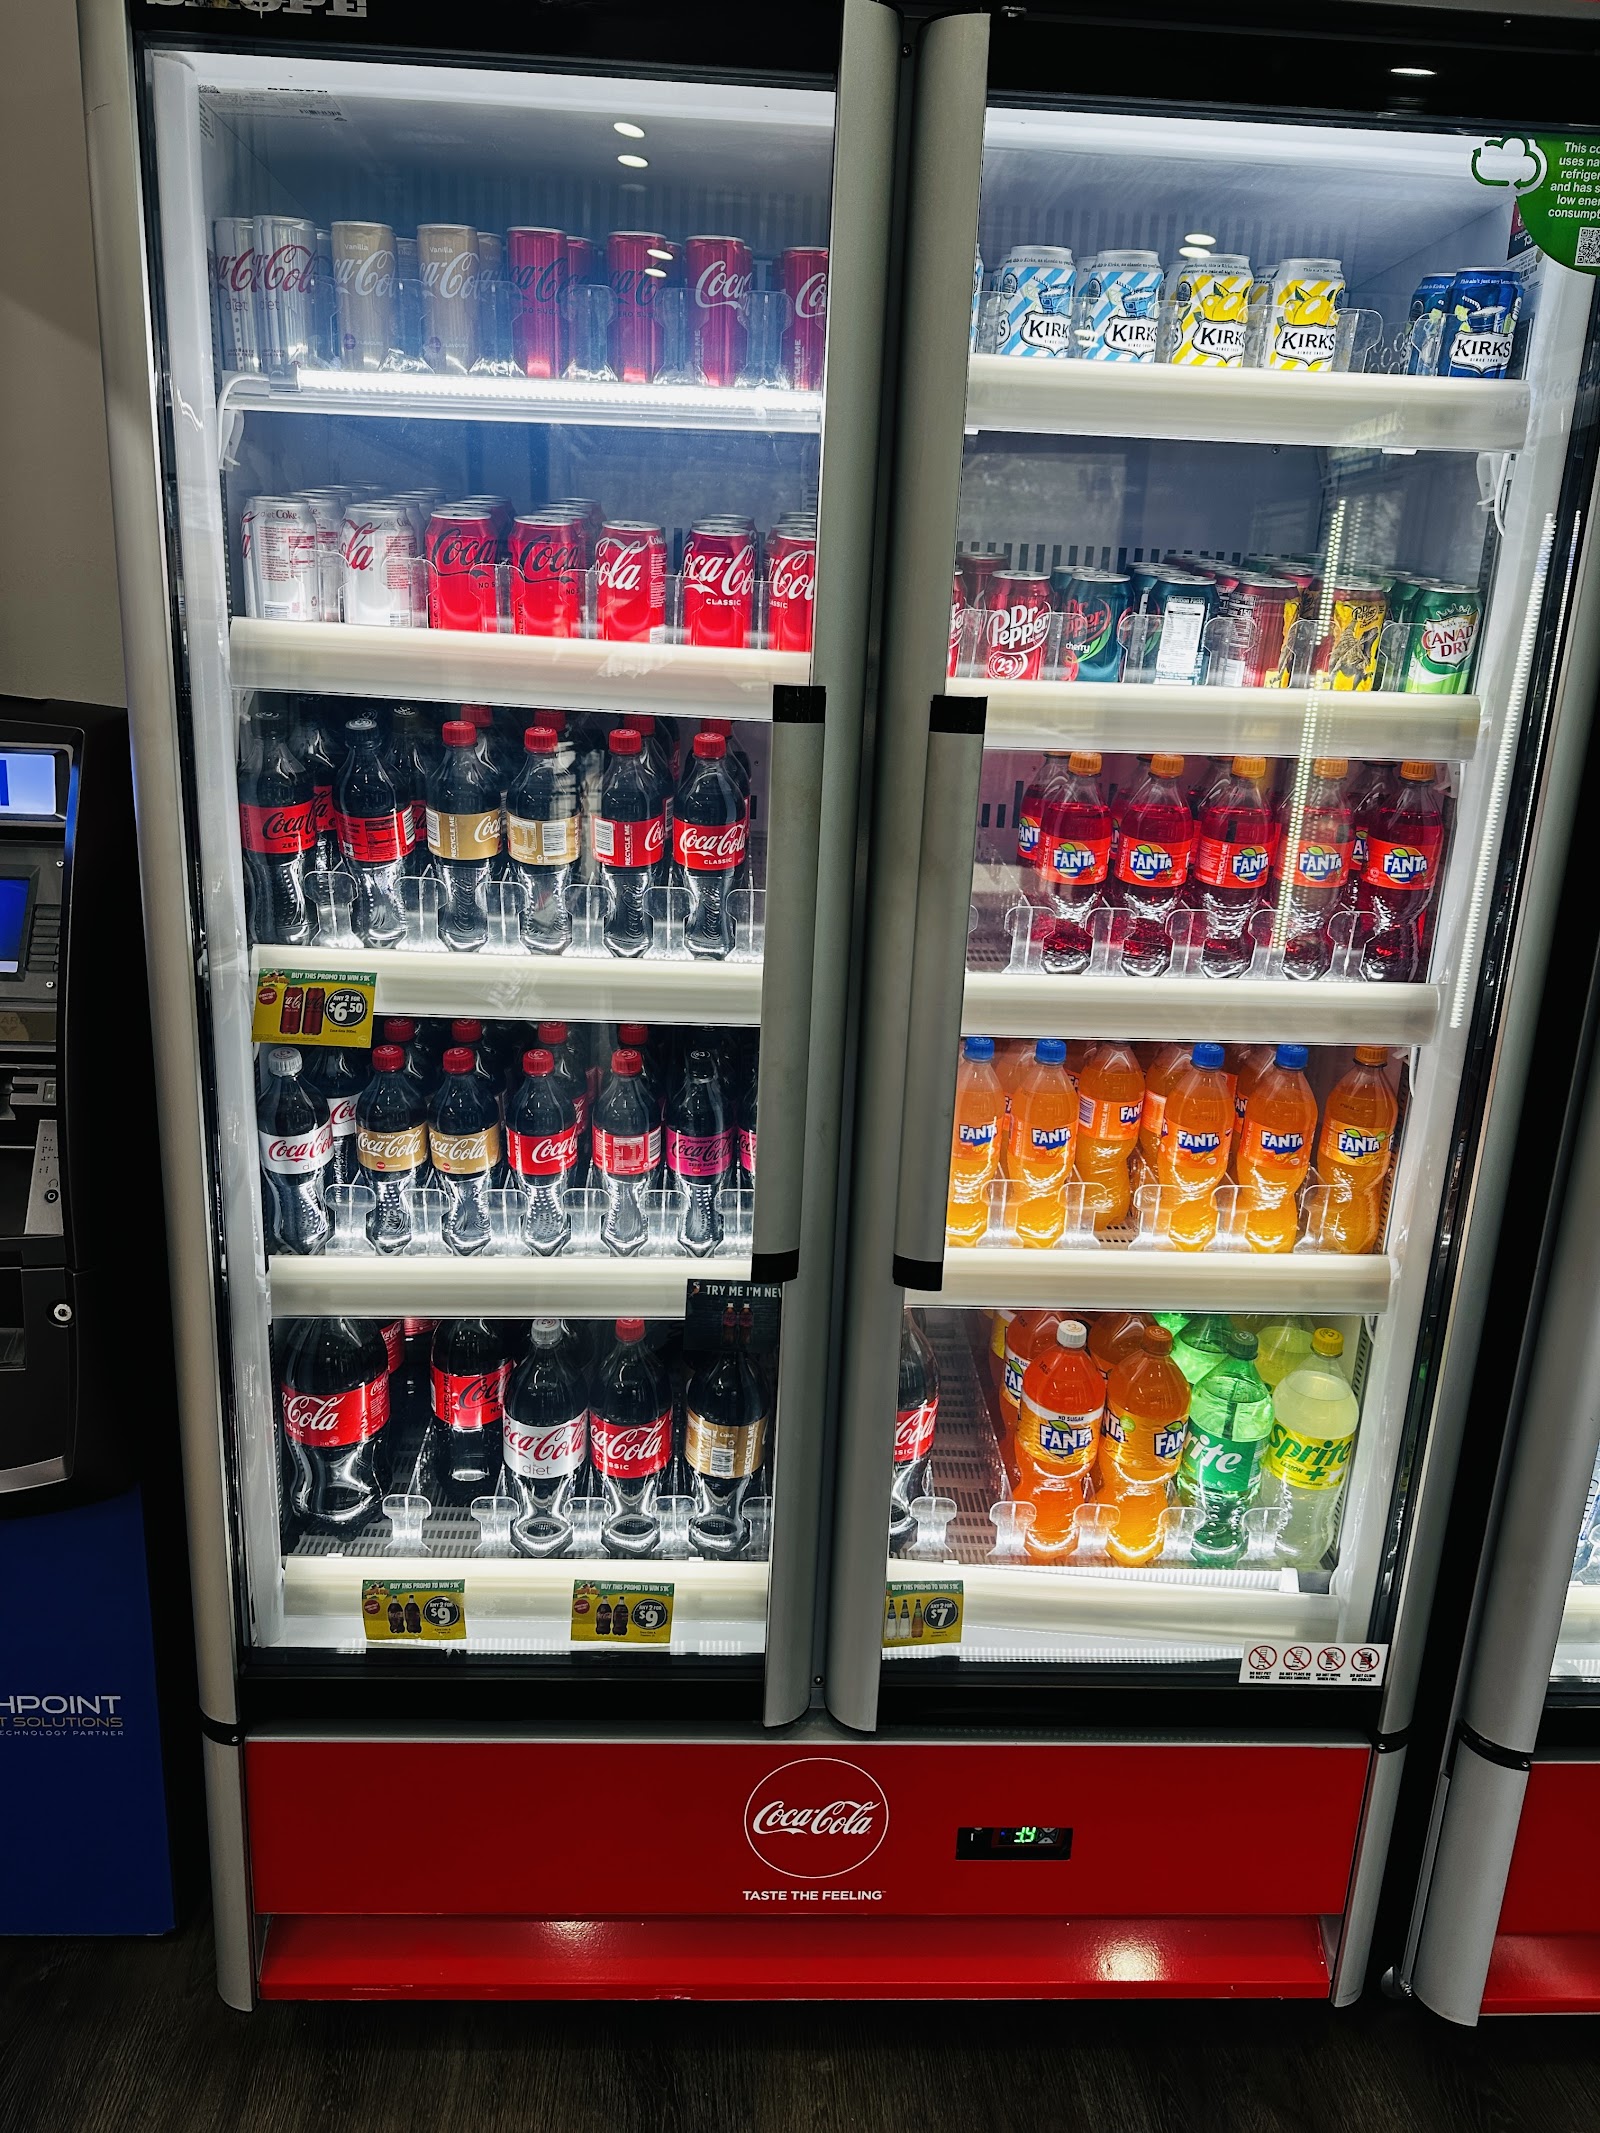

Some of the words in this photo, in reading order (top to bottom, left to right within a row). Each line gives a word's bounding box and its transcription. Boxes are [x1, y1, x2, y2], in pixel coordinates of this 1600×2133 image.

[1564, 142, 1587, 154] This
[1559, 157, 1585, 167] uses
[1550, 182, 1571, 192] and
[1573, 182, 1593, 193] has
[1557, 194, 1576, 205] low
[344, 243, 369, 251] Vanilla
[1281, 332, 1335, 351] KIRKS
[1454, 339, 1511, 358] KIRKS
[276, 509, 298, 520] Coke
[705, 598, 741, 606] CLASSIC
[1010, 604, 1039, 629] Dr
[1239, 609, 1252, 617] 150
[1352, 606, 1377, 621] Pepper
[988, 609, 1050, 650] Pepper
[1065, 641, 1091, 654] cherry
[1441, 639, 1471, 658] DRY
[997, 657, 1013, 674] 23
[449, 816, 455, 827] ME
[624, 824, 631, 837] ME
[679, 823, 747, 857] Coca-Cola
[1220, 843, 1229, 856] ME
[703, 857, 733, 865] CLASSIC
[1053, 850, 1096, 868] FANTA
[1129, 850, 1173, 869] FANTA
[1232, 854, 1269, 873] FANTA
[1299, 851, 1342, 871] FANTA
[1383, 852, 1428, 872] FANTA
[1215, 856, 1226, 885] RECYCLE
[304, 972, 317, 980] THIS
[317, 973, 338, 981] PROMO
[347, 974, 359, 982] WIN
[345, 994, 350, 1002] 2
[329, 1001, 363, 1022] $6.50
[1101, 1103, 1109, 1113] ME
[959, 1125, 998, 1141] FANTA
[1099, 1113, 1108, 1138] RECYCLE
[357, 1129, 421, 1160] Coca-Cola
[1032, 1129, 1071, 1145] FANTA
[1177, 1131, 1220, 1149] FANTA
[1261, 1131, 1304, 1149] FANTA
[1338, 1133, 1381, 1154] FANTA
[706, 1284, 726, 1296] TRY
[728, 1285, 744, 1297] ME
[746, 1286, 761, 1298] I'M
[747, 1423, 756, 1440] ME
[1040, 1424, 1094, 1450] FANTA
[1270, 1422, 1353, 1474] Sprite
[594, 1454, 630, 1471] CLASSIC
[743, 1440, 755, 1476] RECYCLE
[522, 1463, 552, 1476] diet
[1280, 1461, 1304, 1474] LEMON
[430, 1607, 451, 1625] $9
[638, 1610, 658, 1628] $9
[930, 1608, 948, 1627] $7
[13, 1717, 124, 1728] SOLUTIONS
[753, 1800, 881, 1836] Coca-Cola
[743, 1890, 788, 1901] TASTE
[790, 1890, 819, 1901] THE
[822, 1890, 882, 1901] FEELING
